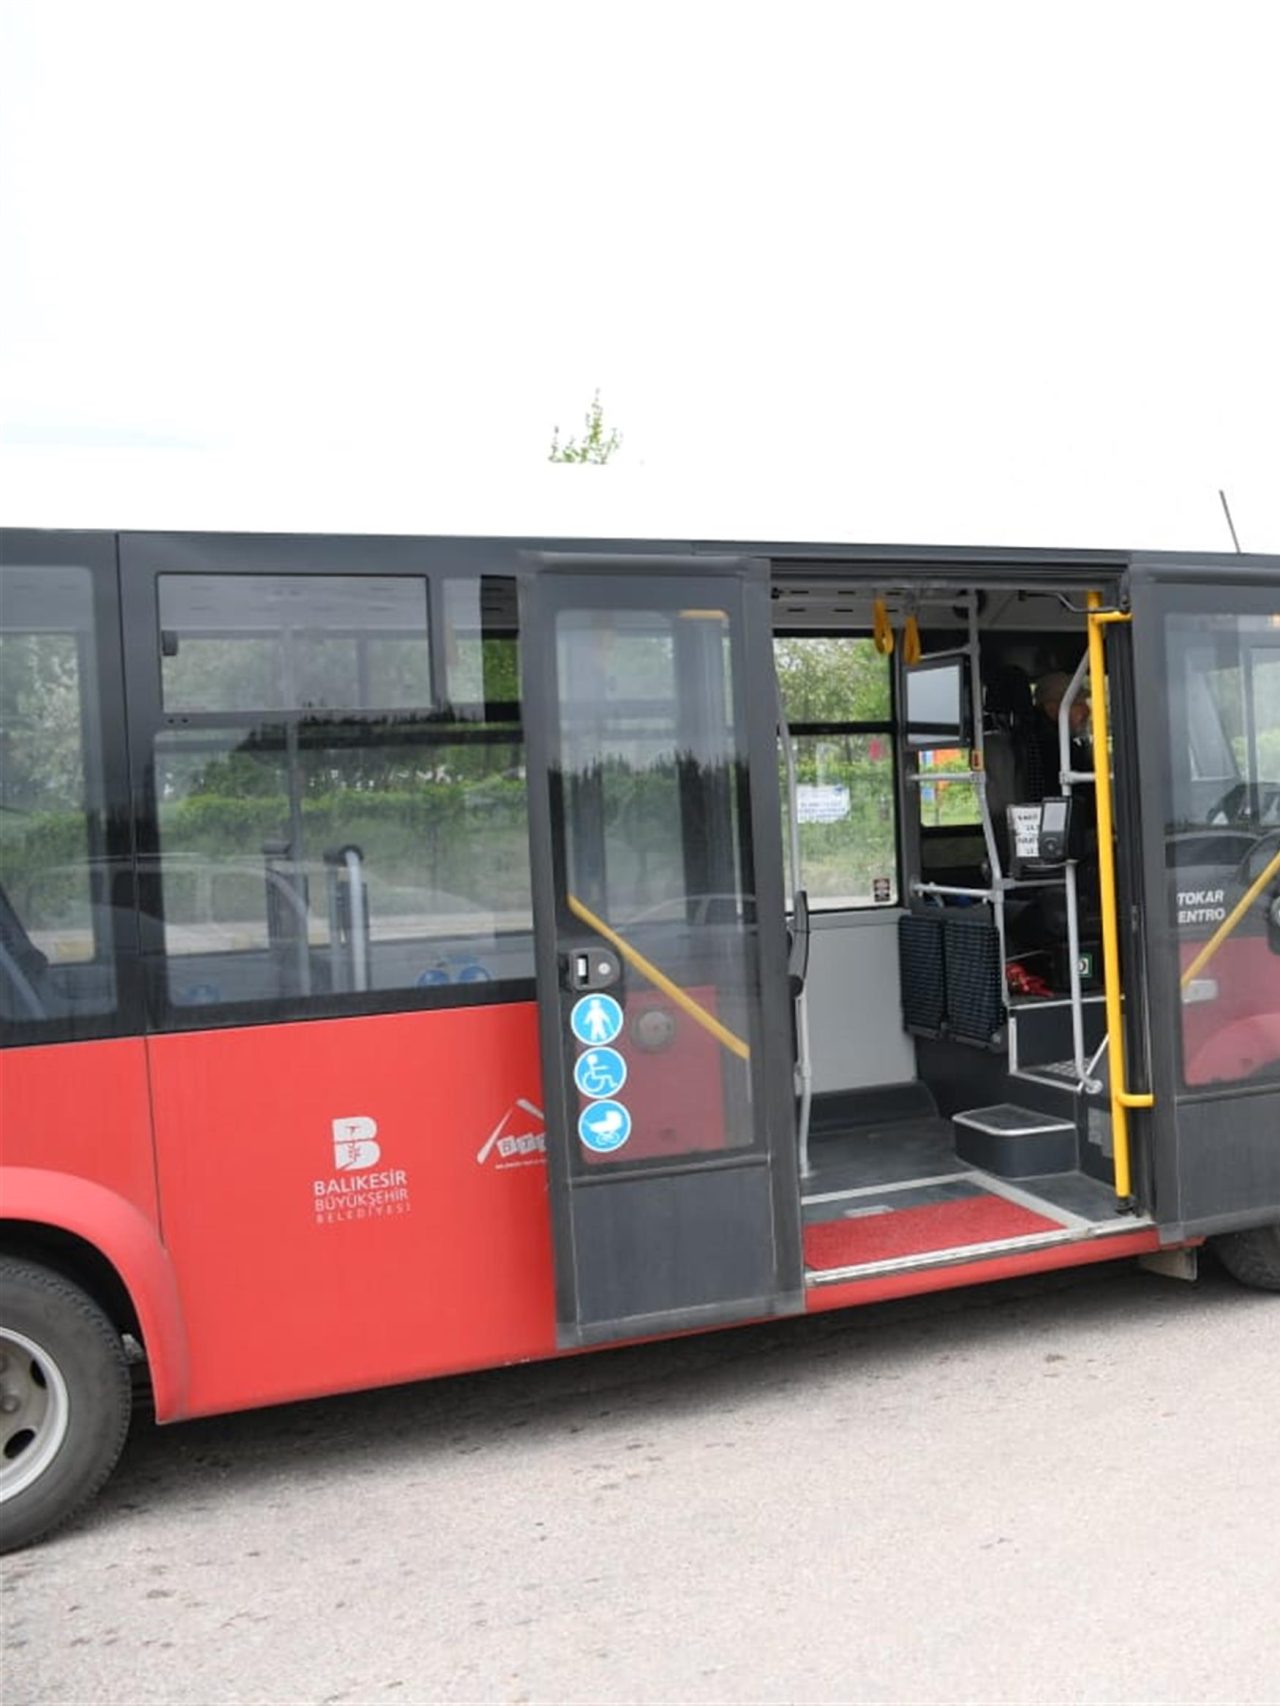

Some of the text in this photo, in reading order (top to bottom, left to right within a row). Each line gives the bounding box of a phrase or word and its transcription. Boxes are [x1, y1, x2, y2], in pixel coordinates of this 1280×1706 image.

[1177, 889, 1225, 907] TOKAR
[1178, 907, 1226, 924] ENTRO
[314, 1169, 407, 1196] BALIKESİR
[315, 1187, 408, 1213] BÜYÜKŞEHİR
